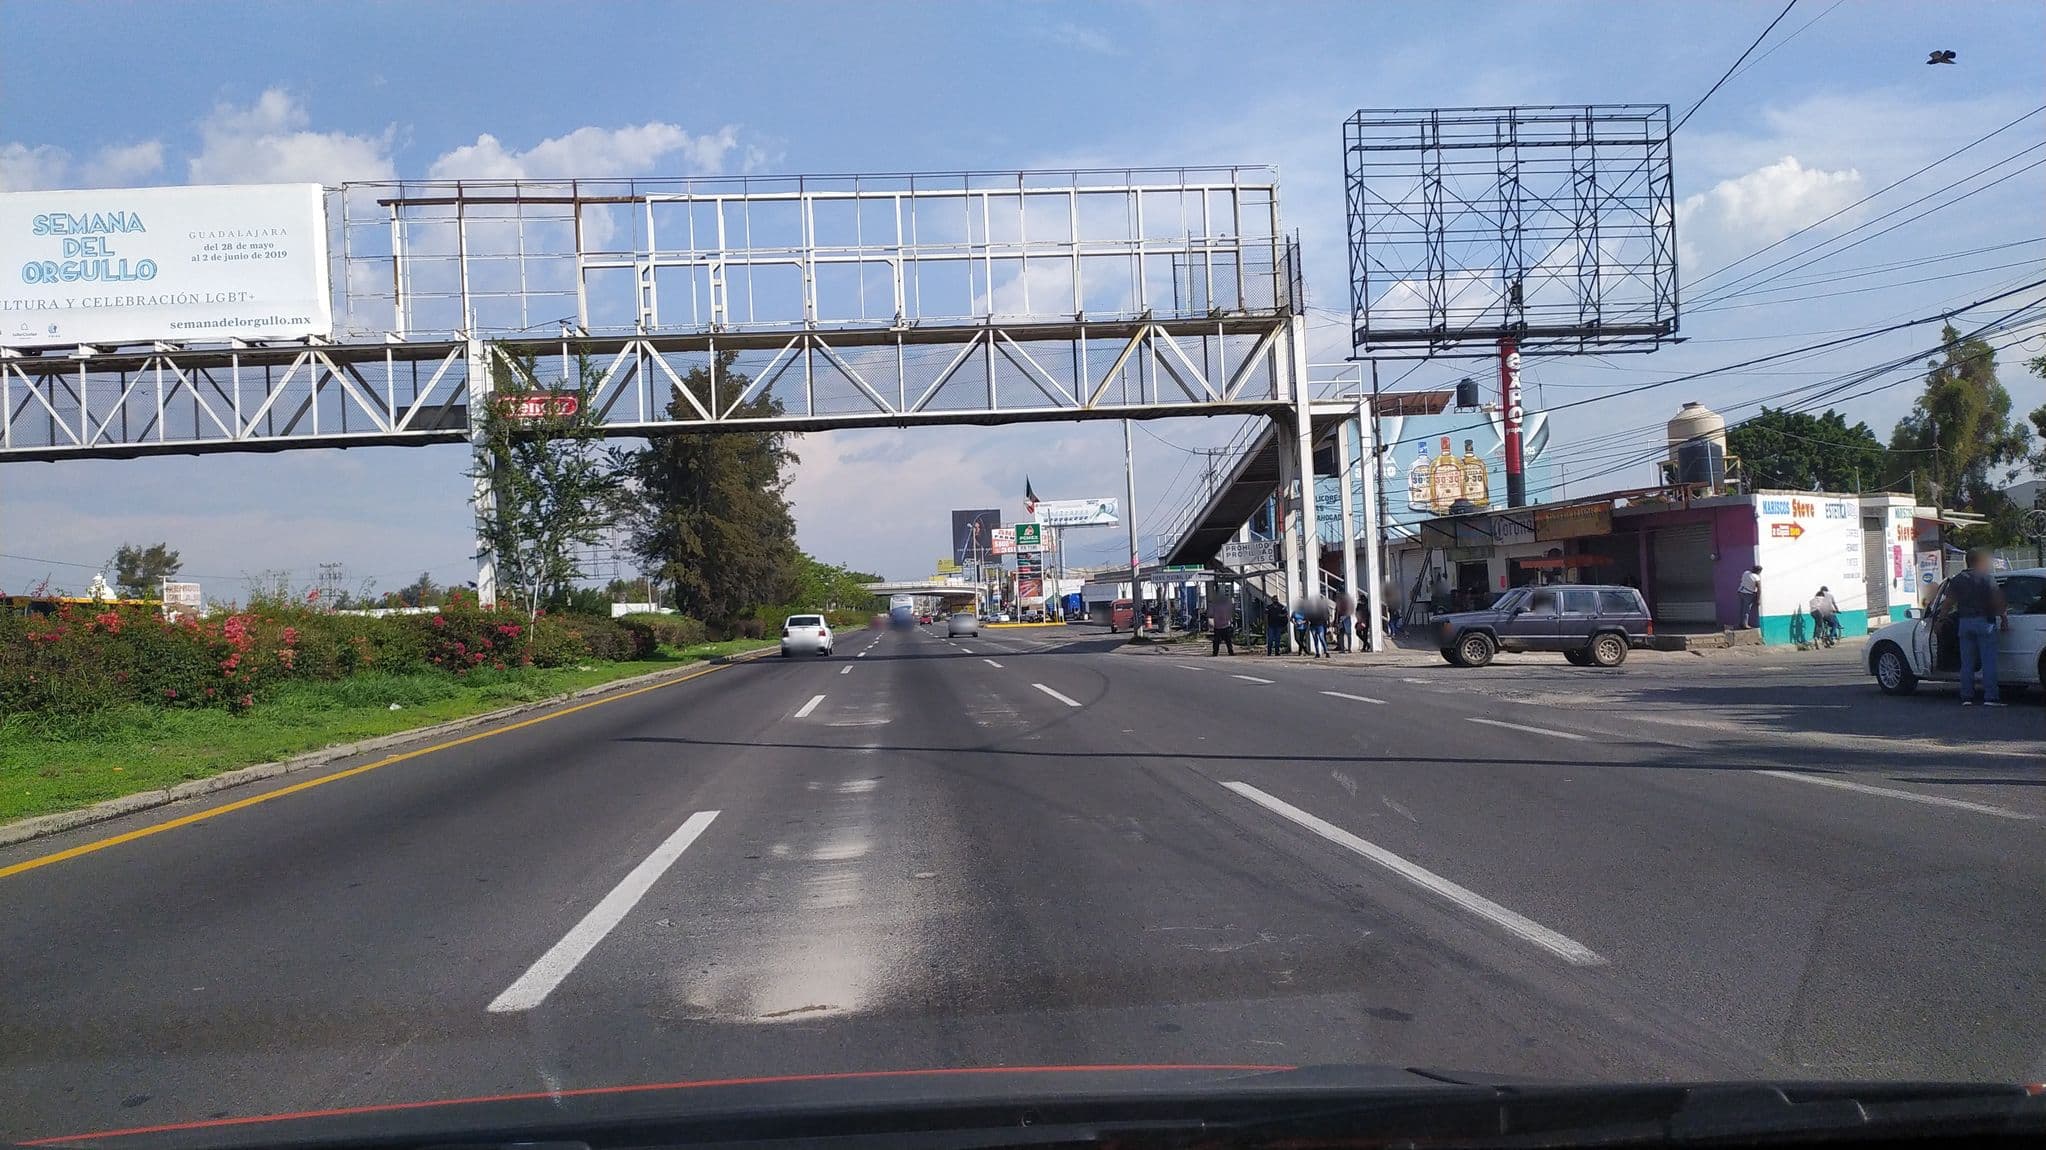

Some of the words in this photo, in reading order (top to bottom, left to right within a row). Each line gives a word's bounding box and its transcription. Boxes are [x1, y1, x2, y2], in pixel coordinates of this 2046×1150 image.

[32, 211, 146, 235] SEMANA
[189, 228, 287, 239] GUADALAJARA
[63, 236, 115, 258] DEL
[203, 243, 218, 251] del
[236, 242, 247, 250] de
[250, 242, 274, 251] mayo
[211, 253, 222, 261] de
[224, 252, 249, 262] junio
[251, 251, 262, 259] de
[264, 250, 287, 259] 2019
[22, 258, 157, 284] ORGULLO
[66, 298, 75, 309] Y
[82, 292, 200, 308] CELEBRACIÓN
[206, 291, 255, 304] LGBT+
[170, 315, 311, 330] semanadelorgullo.mx
[1762, 500, 1790, 515] MARISCOS
[1792, 498, 1815, 518] Steve
[1494, 518, 1532, 541] Corona
[1897, 523, 1918, 541] Steve
